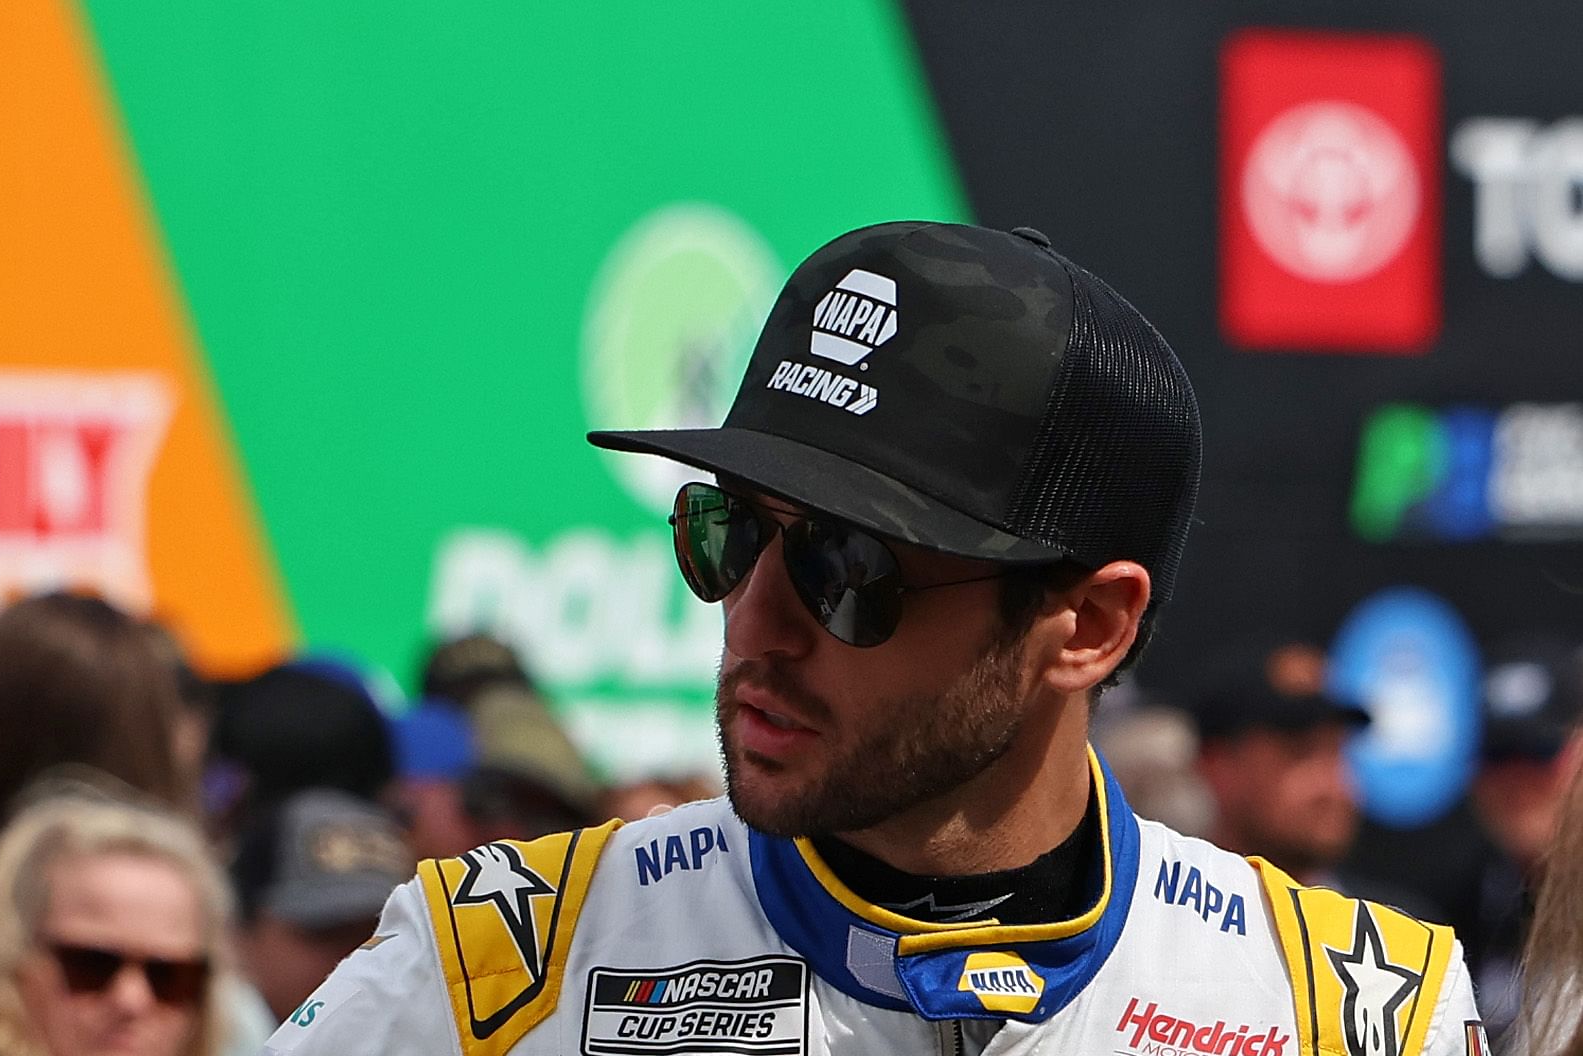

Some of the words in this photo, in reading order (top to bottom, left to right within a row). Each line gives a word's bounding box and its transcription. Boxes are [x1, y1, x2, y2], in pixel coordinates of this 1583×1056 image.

[819, 292, 887, 345] NAPA
[766, 360, 859, 408] RACING
[1154, 856, 1247, 936] NAPA
[662, 969, 774, 1004] NASCAR
[970, 969, 1037, 994] NAPA
[617, 1015, 676, 1040] CUP
[677, 1011, 776, 1038] SERIES
